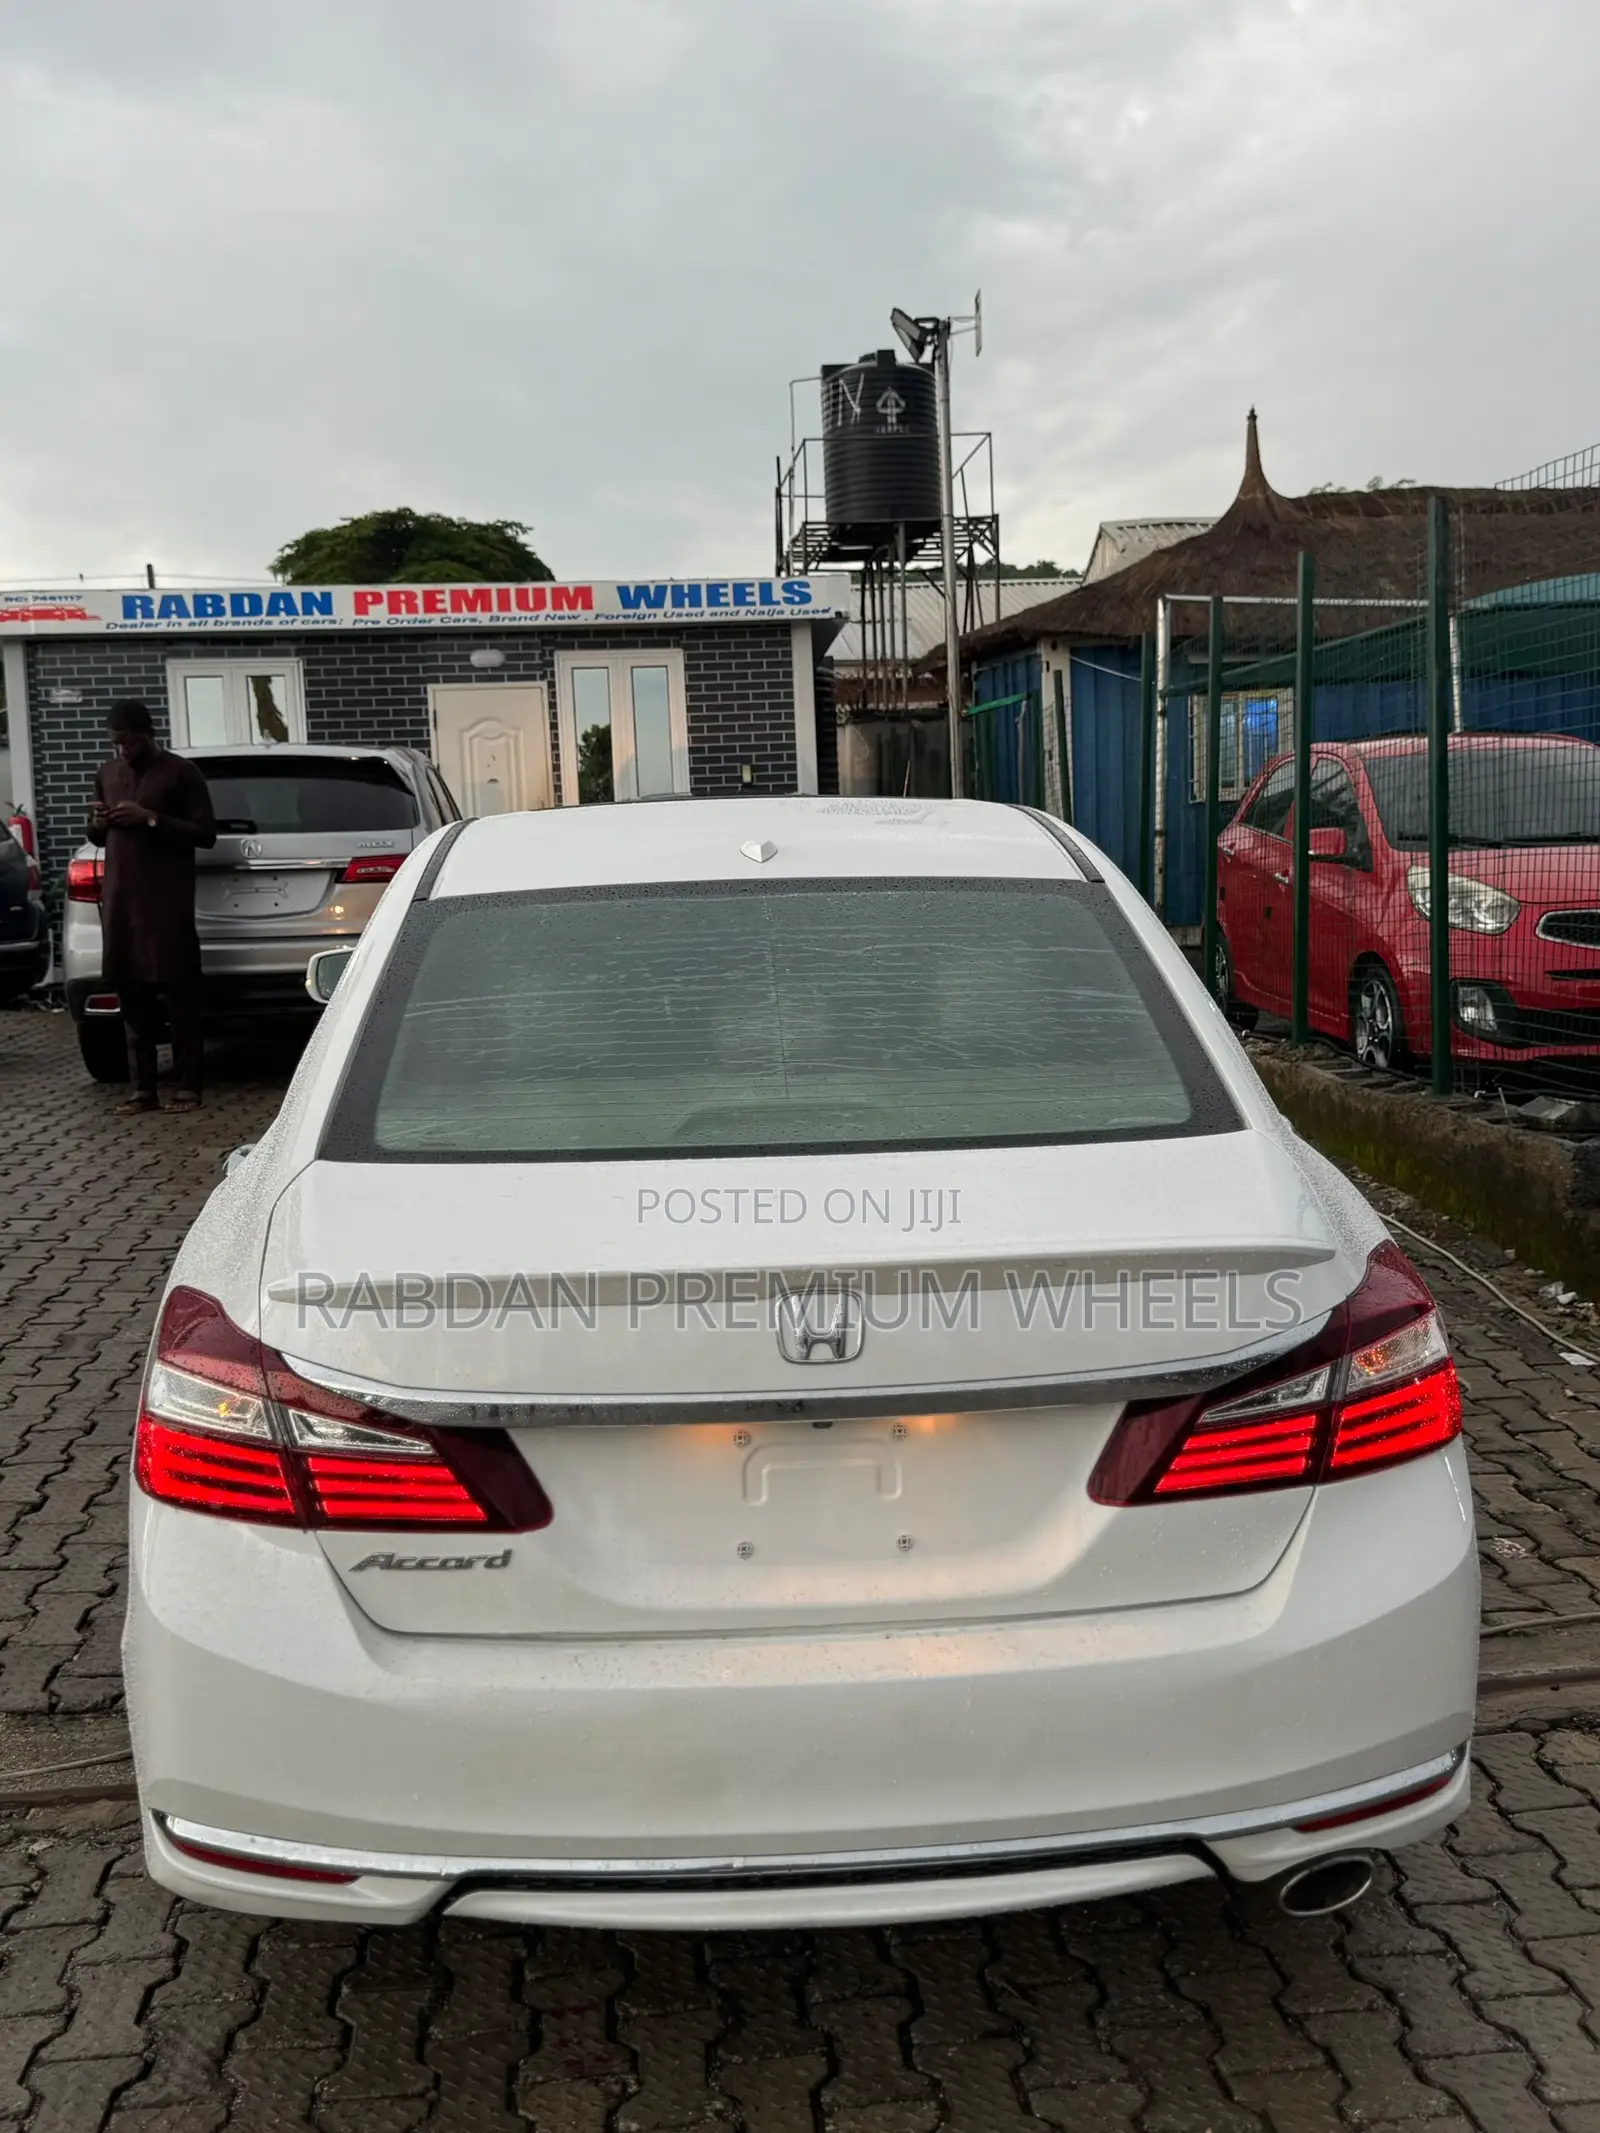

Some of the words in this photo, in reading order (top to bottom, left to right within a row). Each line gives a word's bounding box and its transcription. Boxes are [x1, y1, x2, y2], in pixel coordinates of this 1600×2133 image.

[122, 591, 333, 619] RABDAN
[354, 586, 593, 616] PREMIUM
[616, 581, 812, 610] WHEELS
[106, 621, 161, 630] Dealer
[167, 620, 182, 628] in
[213, 618, 274, 627] brands
[353, 618, 380, 626] Pre
[387, 617, 435, 625] Order
[489, 614, 540, 622] Brand
[544, 613, 581, 621] New
[595, 612, 657, 621] Foreign
[663, 610, 705, 618] Used
[709, 609, 740, 617] and
[790, 607, 831, 616] Used
[348, 1548, 513, 1572] Accord
